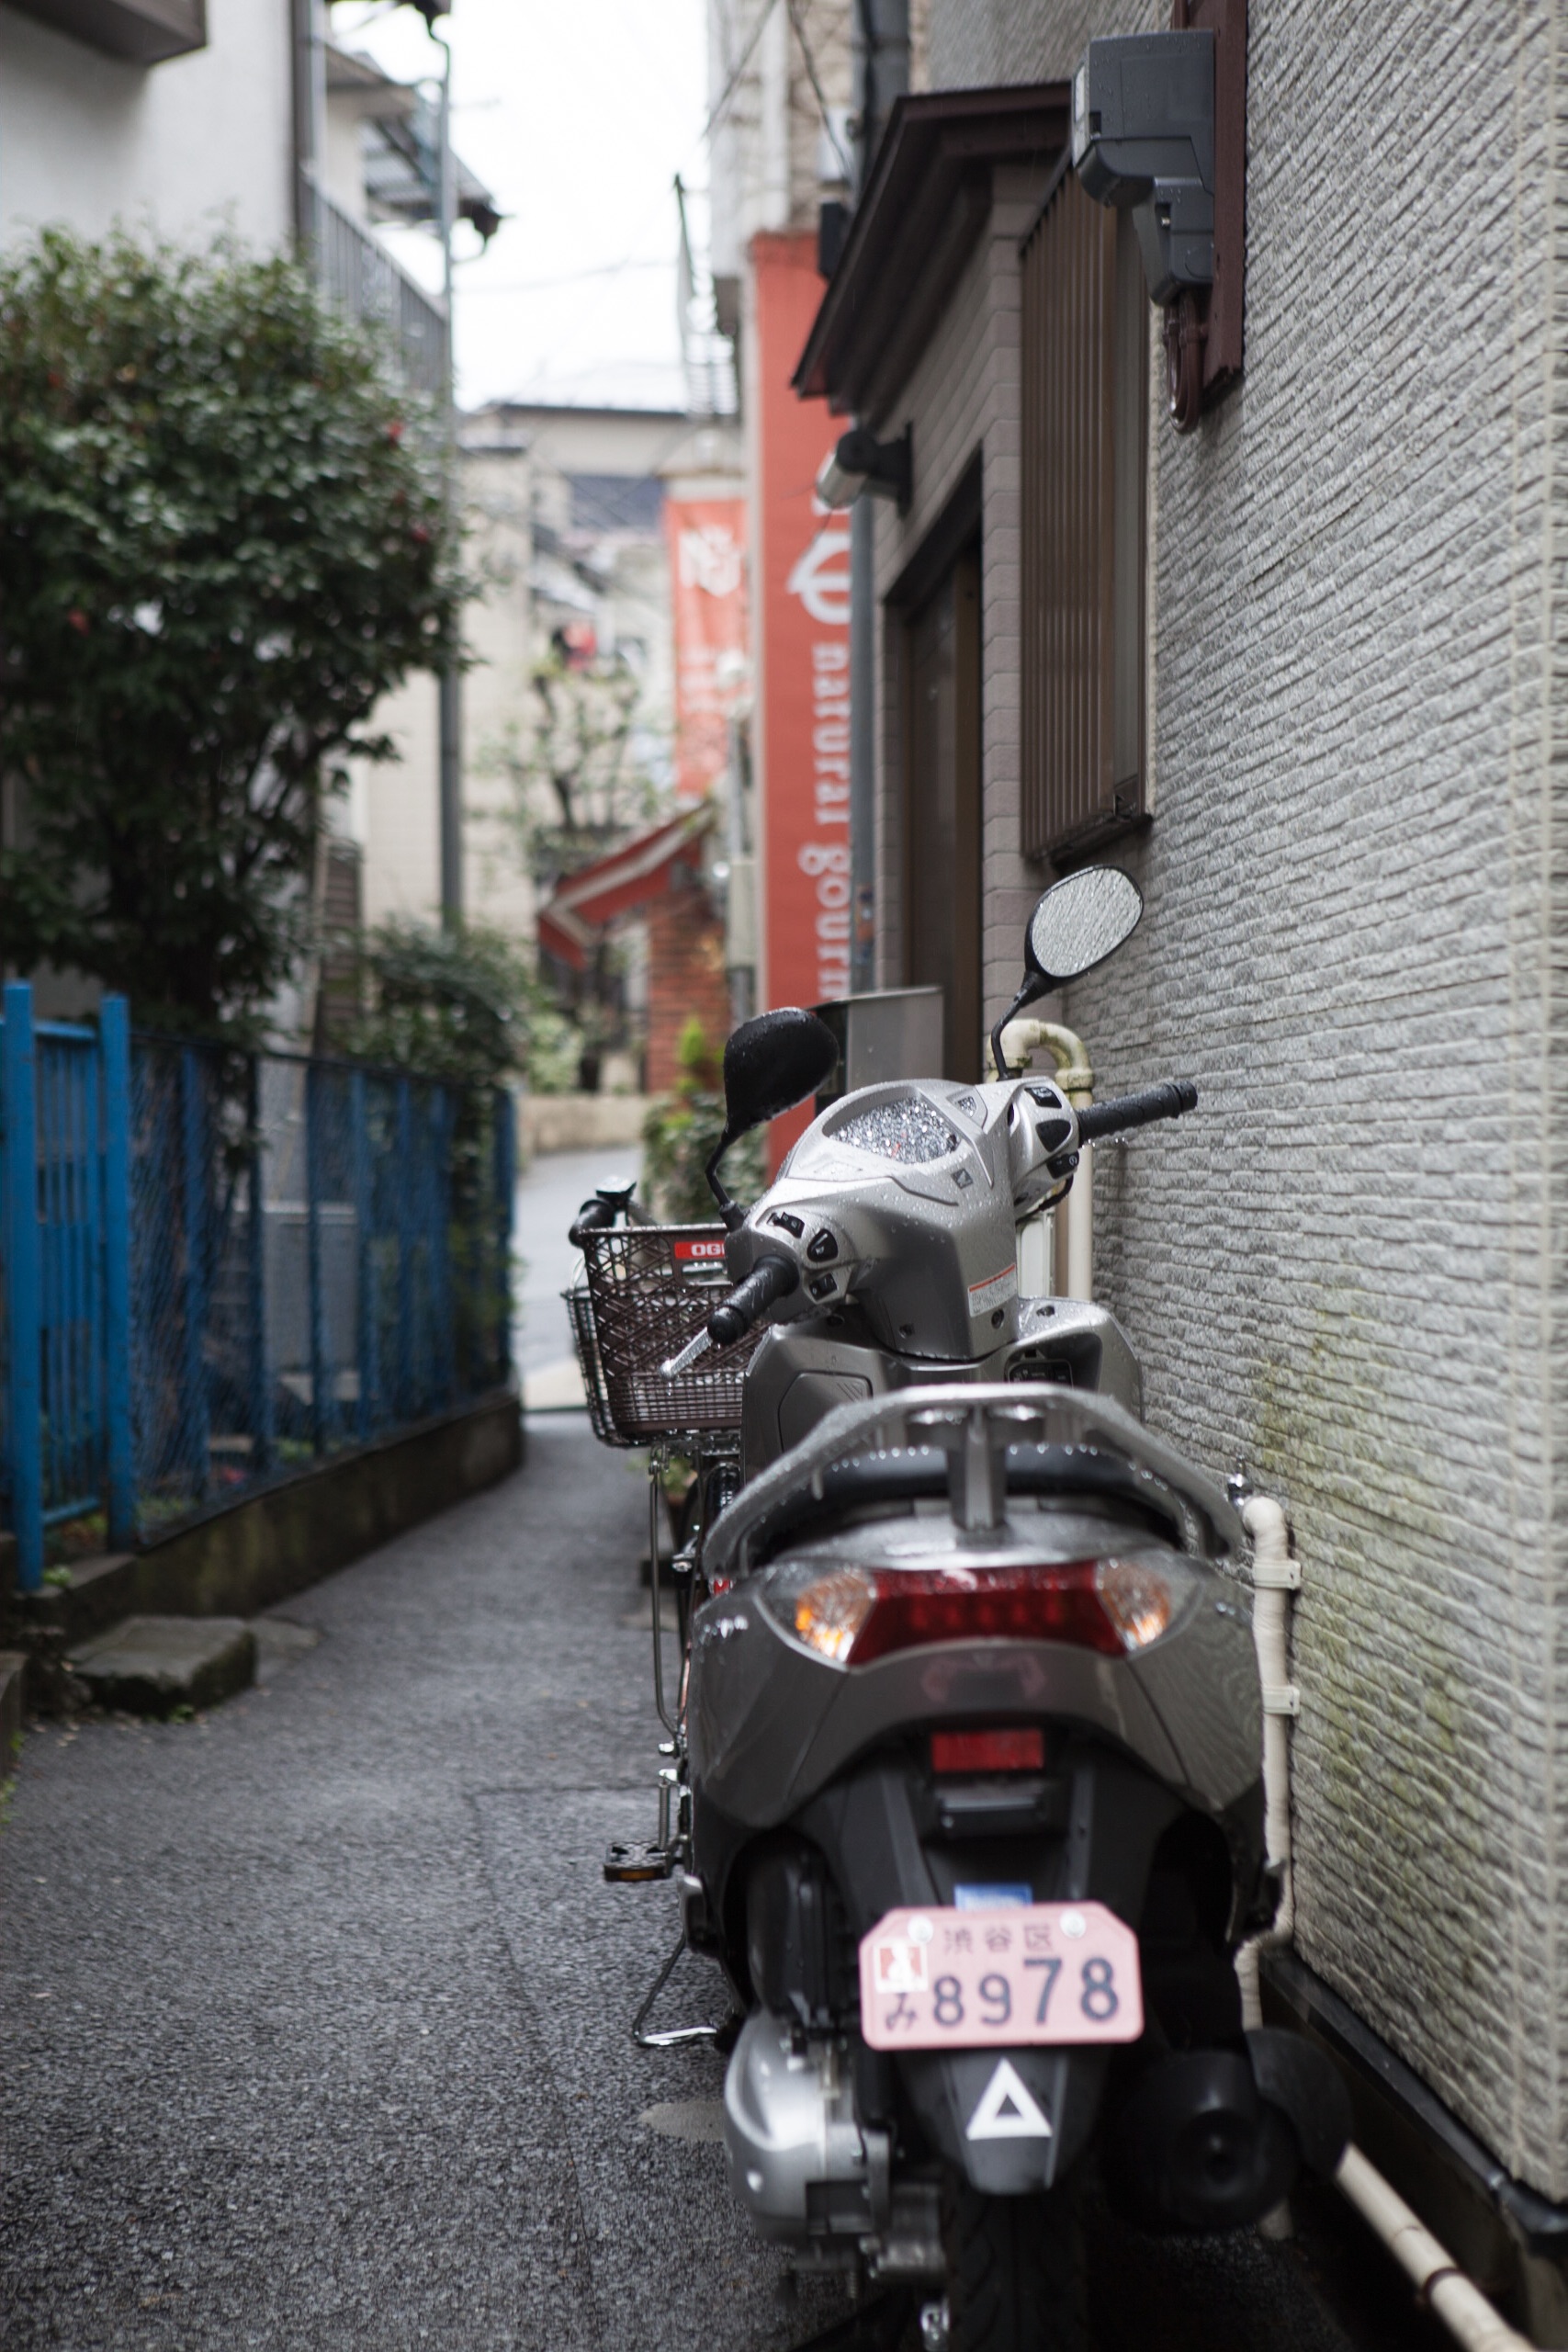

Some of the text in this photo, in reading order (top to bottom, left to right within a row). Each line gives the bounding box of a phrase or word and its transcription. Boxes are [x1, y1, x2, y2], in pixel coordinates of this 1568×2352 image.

[811, 643, 852, 825] natural
[691, 1243, 725, 1257] OG
[942, 1921, 1054, 1954] 渋谷区
[885, 1956, 1120, 2031] み 8978
